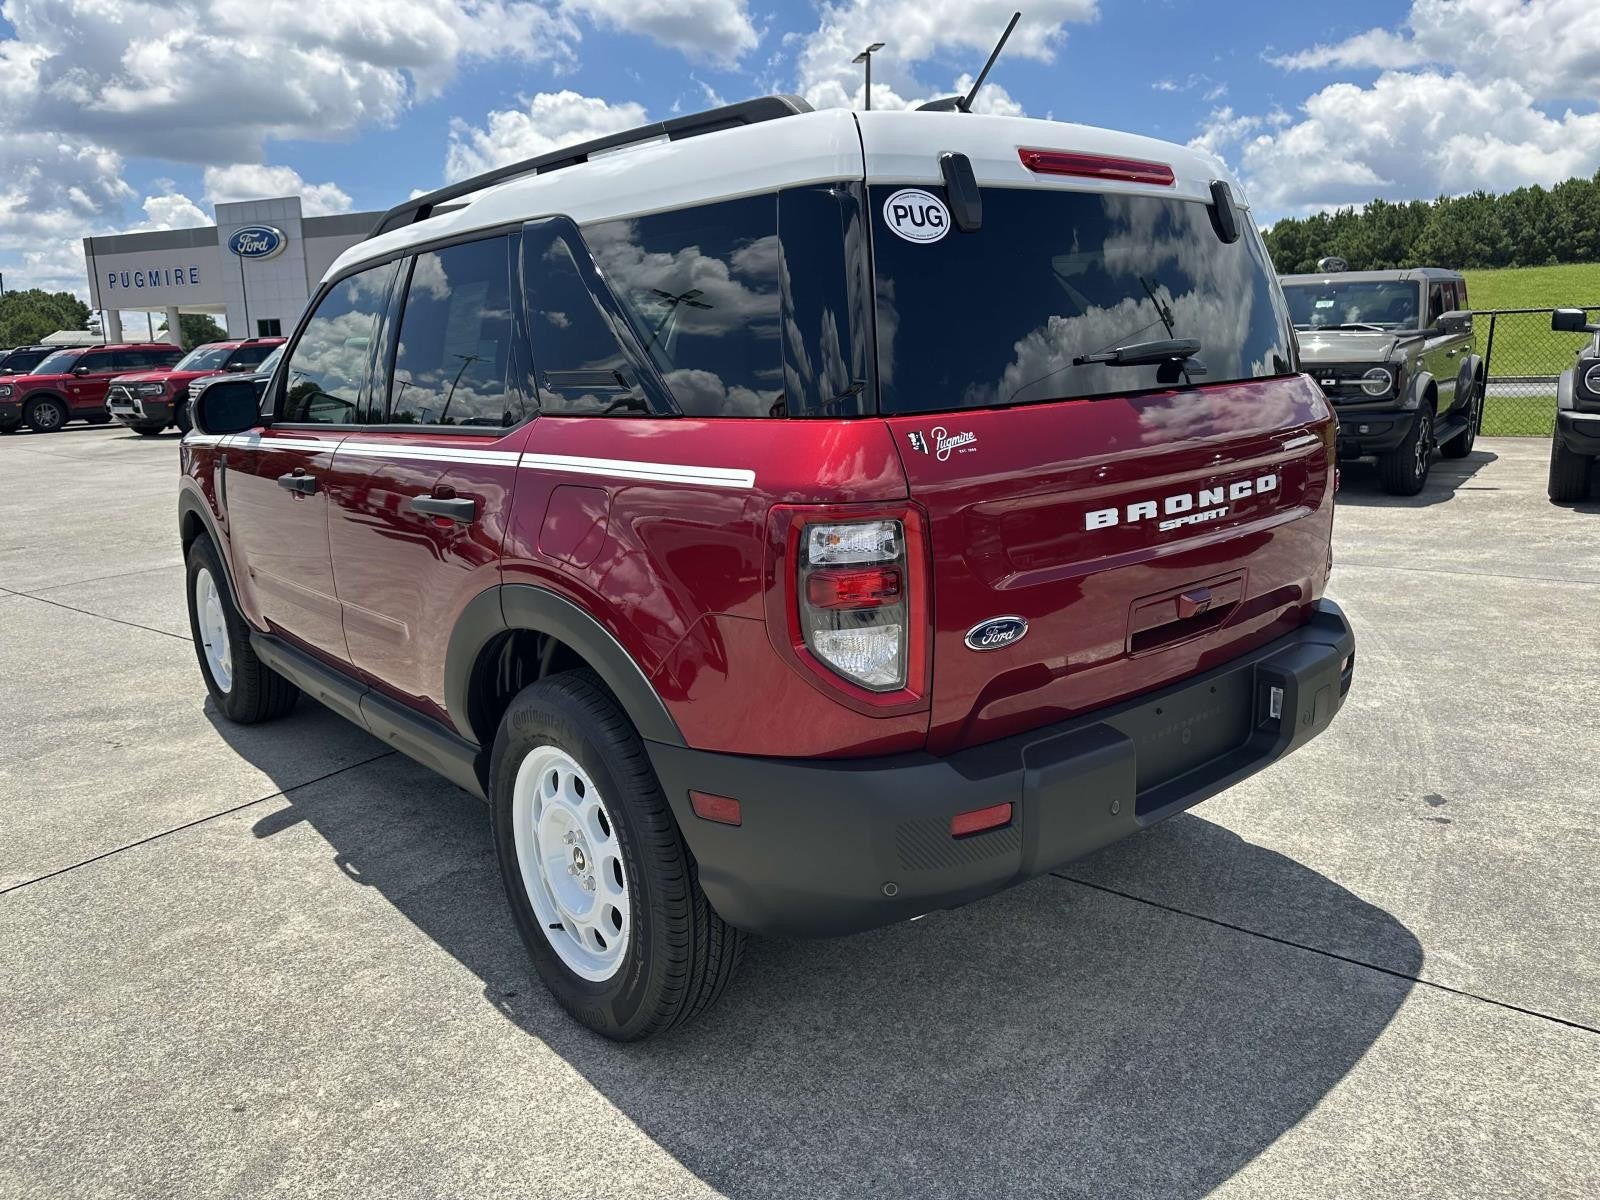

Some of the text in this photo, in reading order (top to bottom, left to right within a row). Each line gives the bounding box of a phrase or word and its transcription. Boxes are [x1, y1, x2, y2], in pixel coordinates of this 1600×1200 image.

[892, 205, 944, 227] PUG
[237, 233, 268, 253] Ford
[108, 267, 199, 289] PUGMIRE
[931, 426, 977, 461] Pugmire
[1085, 473, 1277, 531] BRONCO
[1158, 506, 1229, 532] SPORT
[981, 624, 1016, 645] Ford
